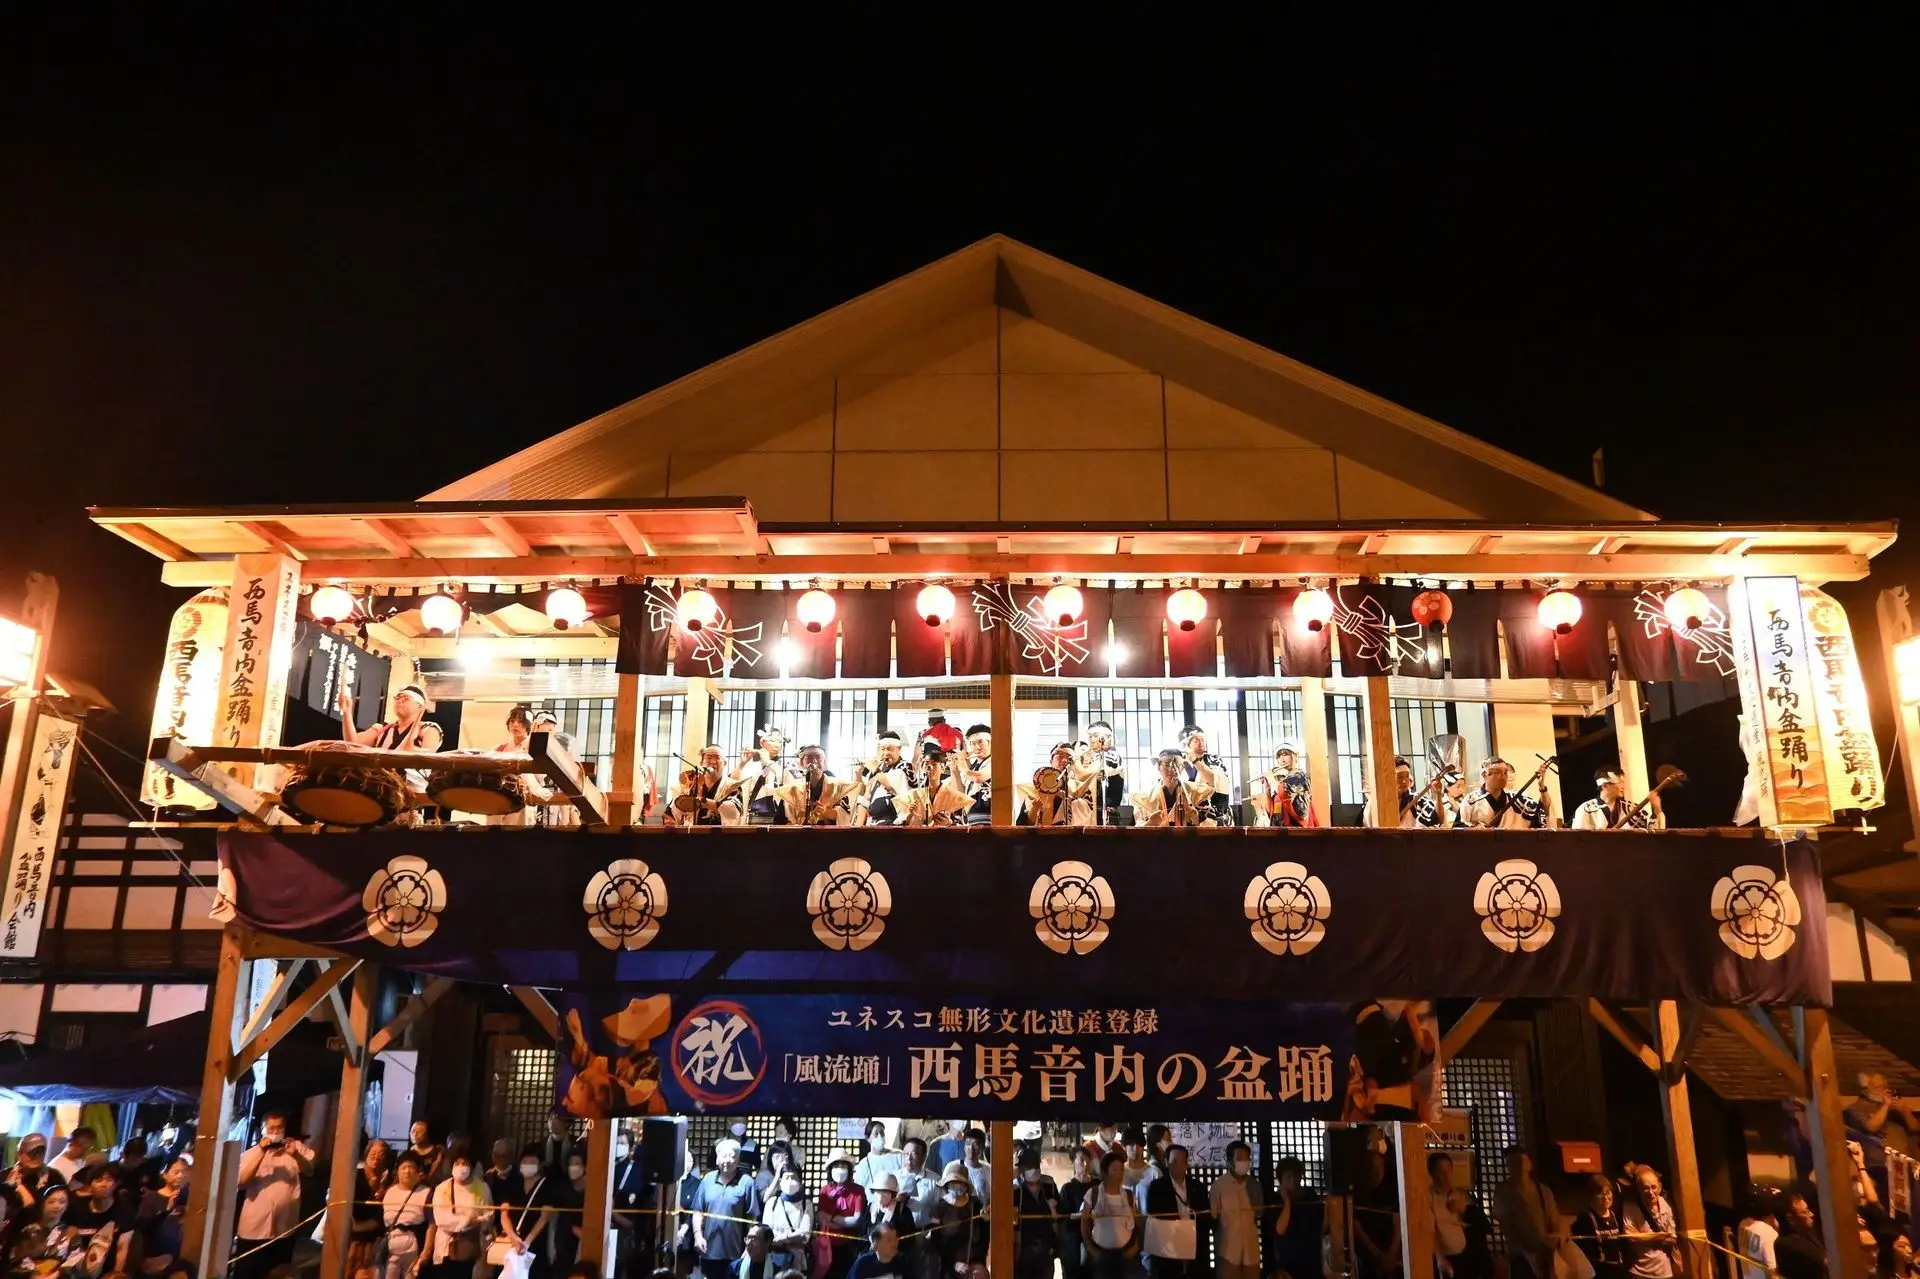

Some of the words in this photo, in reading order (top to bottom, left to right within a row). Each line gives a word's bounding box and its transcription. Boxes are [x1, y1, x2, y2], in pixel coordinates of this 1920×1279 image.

[226, 578, 266, 748] 西馬音内盆踊り
[1767, 608, 1809, 790] 西馬音内盆踊り
[152, 639, 199, 800] 西馬音内り
[3, 852, 32, 951] 盆踊り会館
[23, 846, 46, 920] 西馬音内
[680, 1014, 755, 1086] 祝
[828, 1006, 1159, 1034] ユネスコ無形文化遺産登録
[783, 1053, 891, 1086] 「風流踊」
[908, 1041, 1333, 1102] 西馬音内の盆踊
